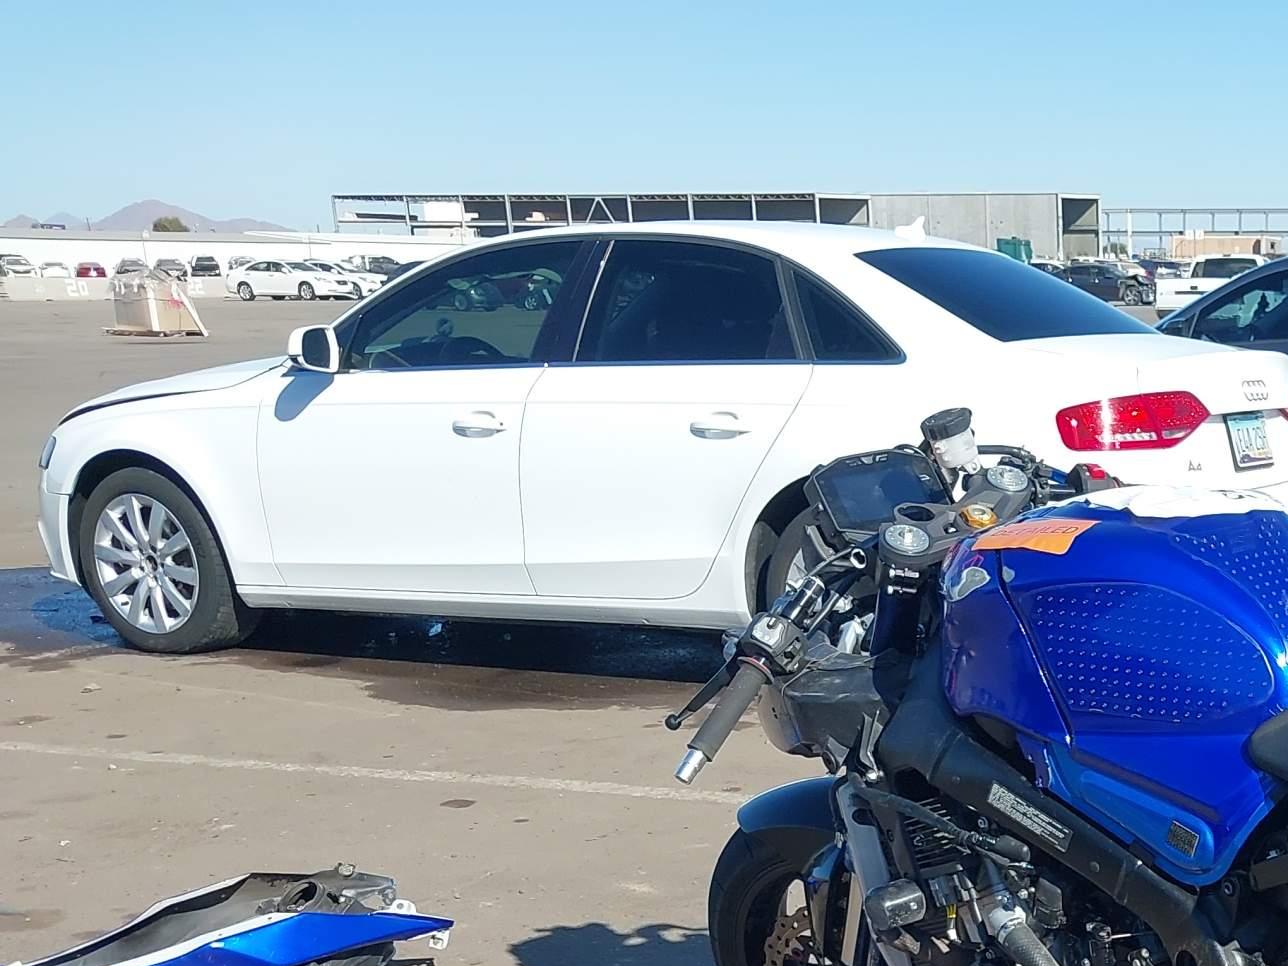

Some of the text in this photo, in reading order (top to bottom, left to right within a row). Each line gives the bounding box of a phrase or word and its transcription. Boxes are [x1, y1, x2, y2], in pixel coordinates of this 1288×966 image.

[65, 279, 88, 296] 20
[1188, 459, 1203, 471] A4
[991, 525, 1080, 537] DETAILED
